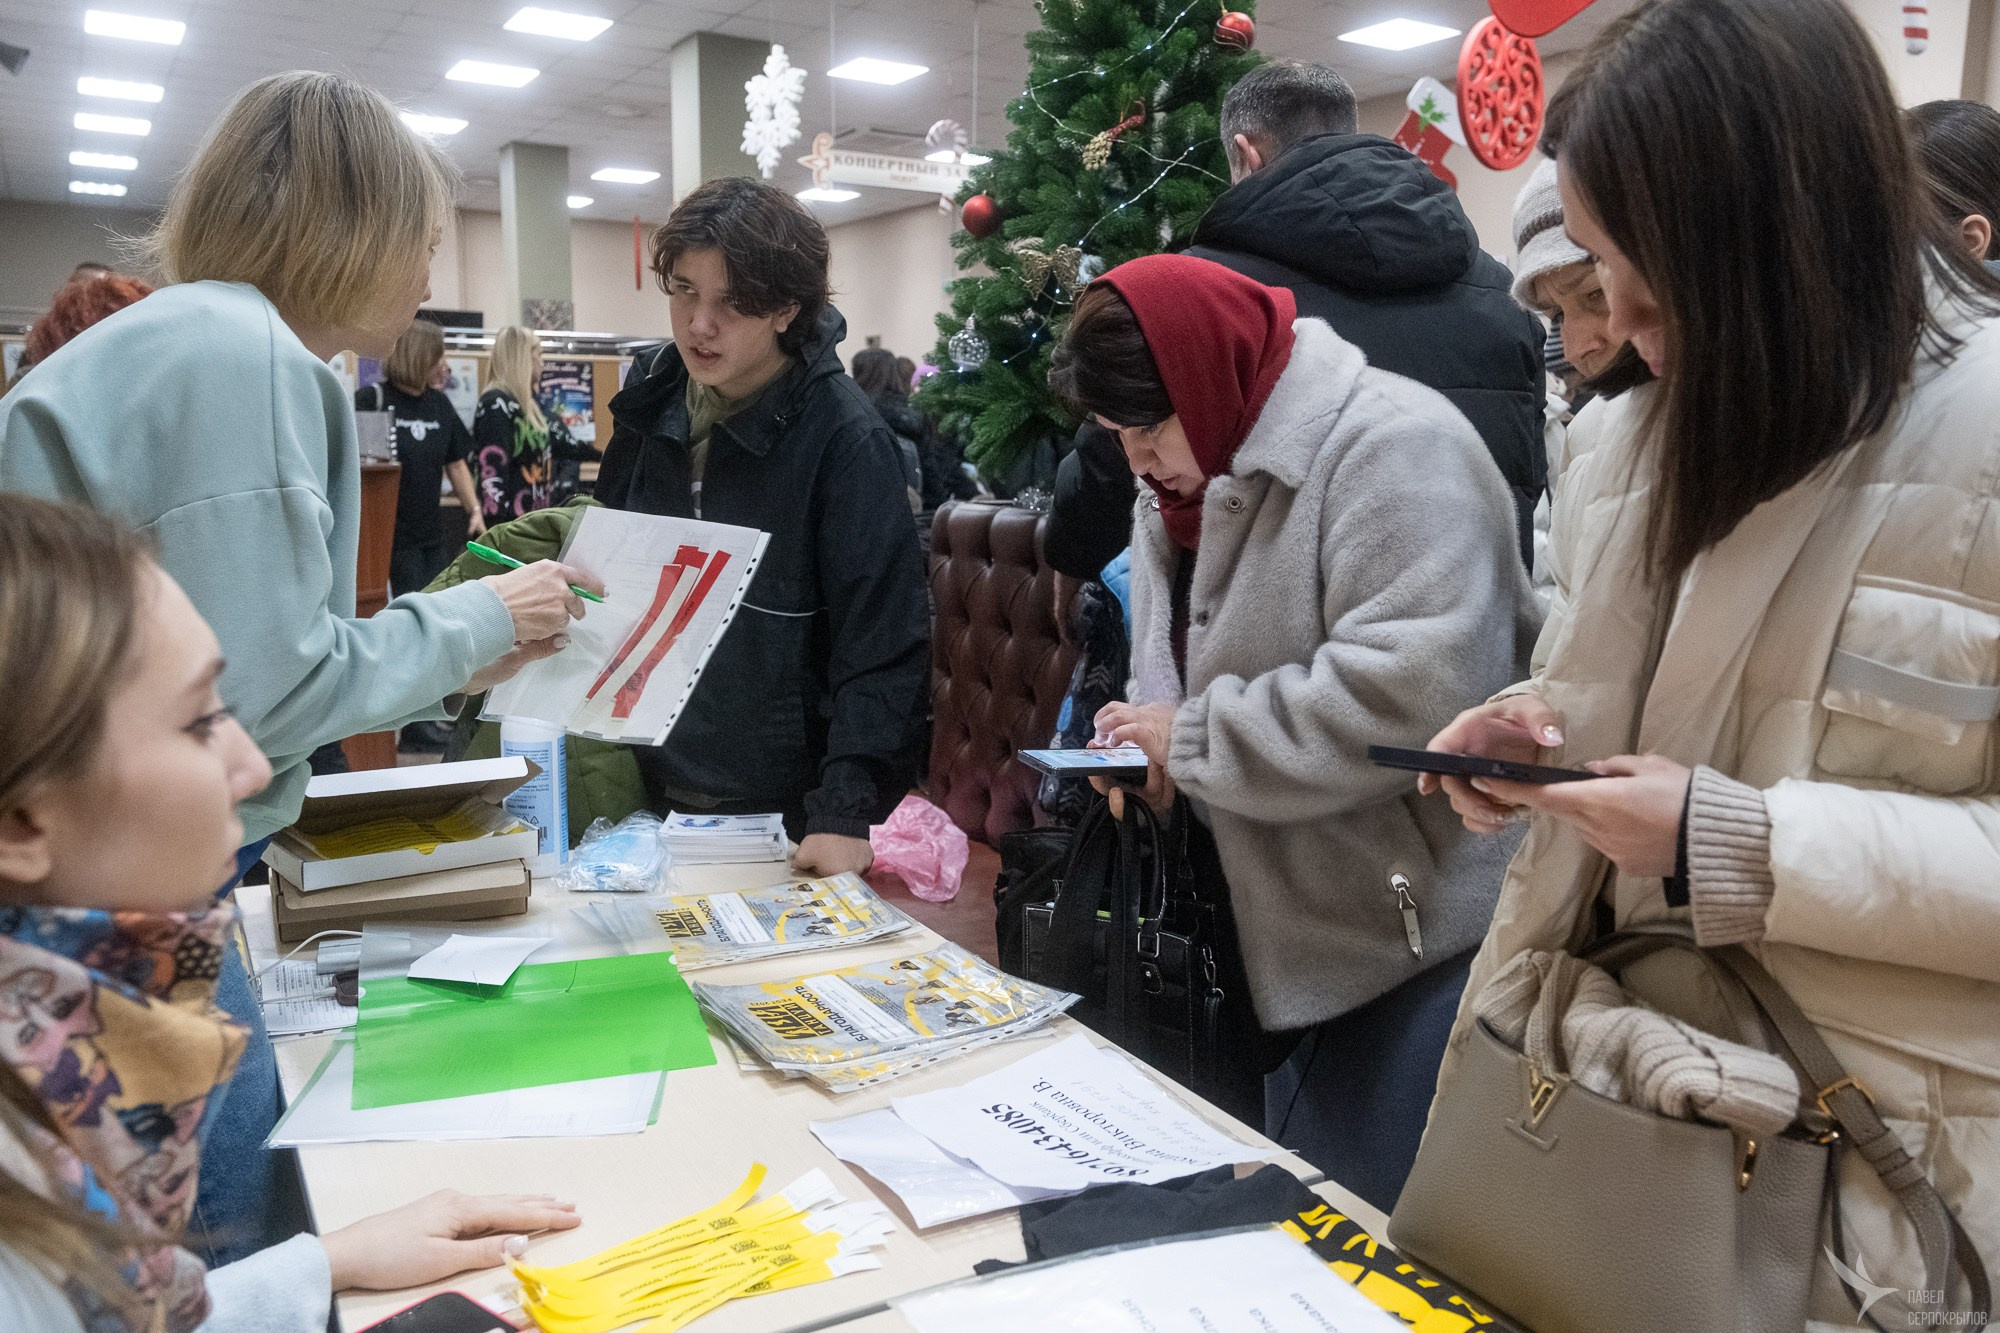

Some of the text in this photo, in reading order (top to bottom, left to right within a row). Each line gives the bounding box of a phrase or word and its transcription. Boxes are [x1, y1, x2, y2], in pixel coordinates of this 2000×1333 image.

[697, 899, 731, 942] БЛАГОДАРНОСТЬ
[794, 985, 869, 1042] БЛАГОДАРНОСТЬ
[1051, 1091, 1146, 1151] Викторовна
